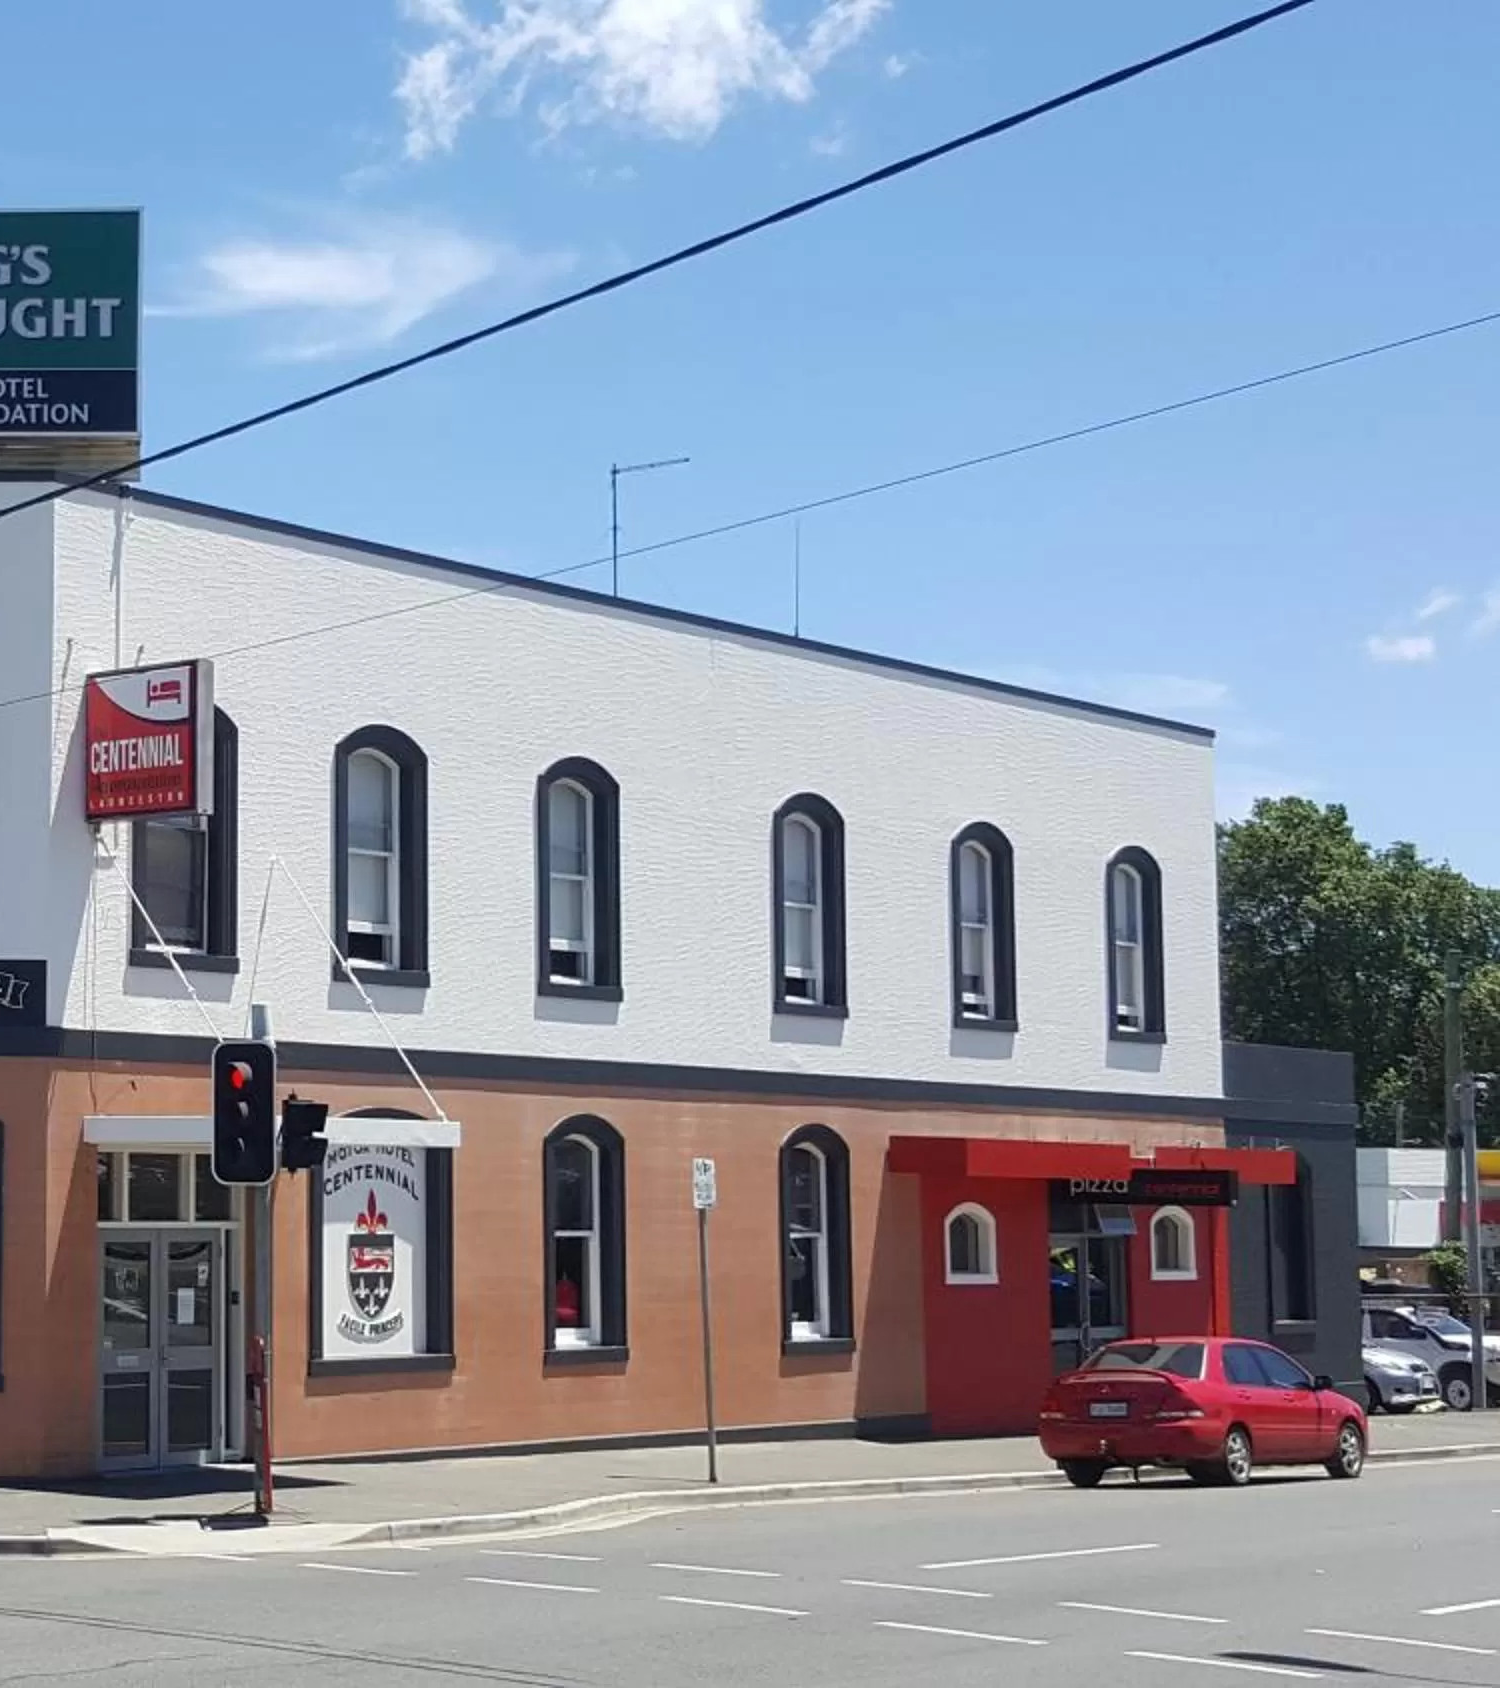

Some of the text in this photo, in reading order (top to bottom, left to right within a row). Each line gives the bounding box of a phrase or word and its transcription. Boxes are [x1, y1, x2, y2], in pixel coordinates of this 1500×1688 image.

[90, 733, 184, 775] CENTENNIAL
[323, 1164, 419, 1201] CENTENNIAL
[1070, 1178, 1129, 1196] pizza
